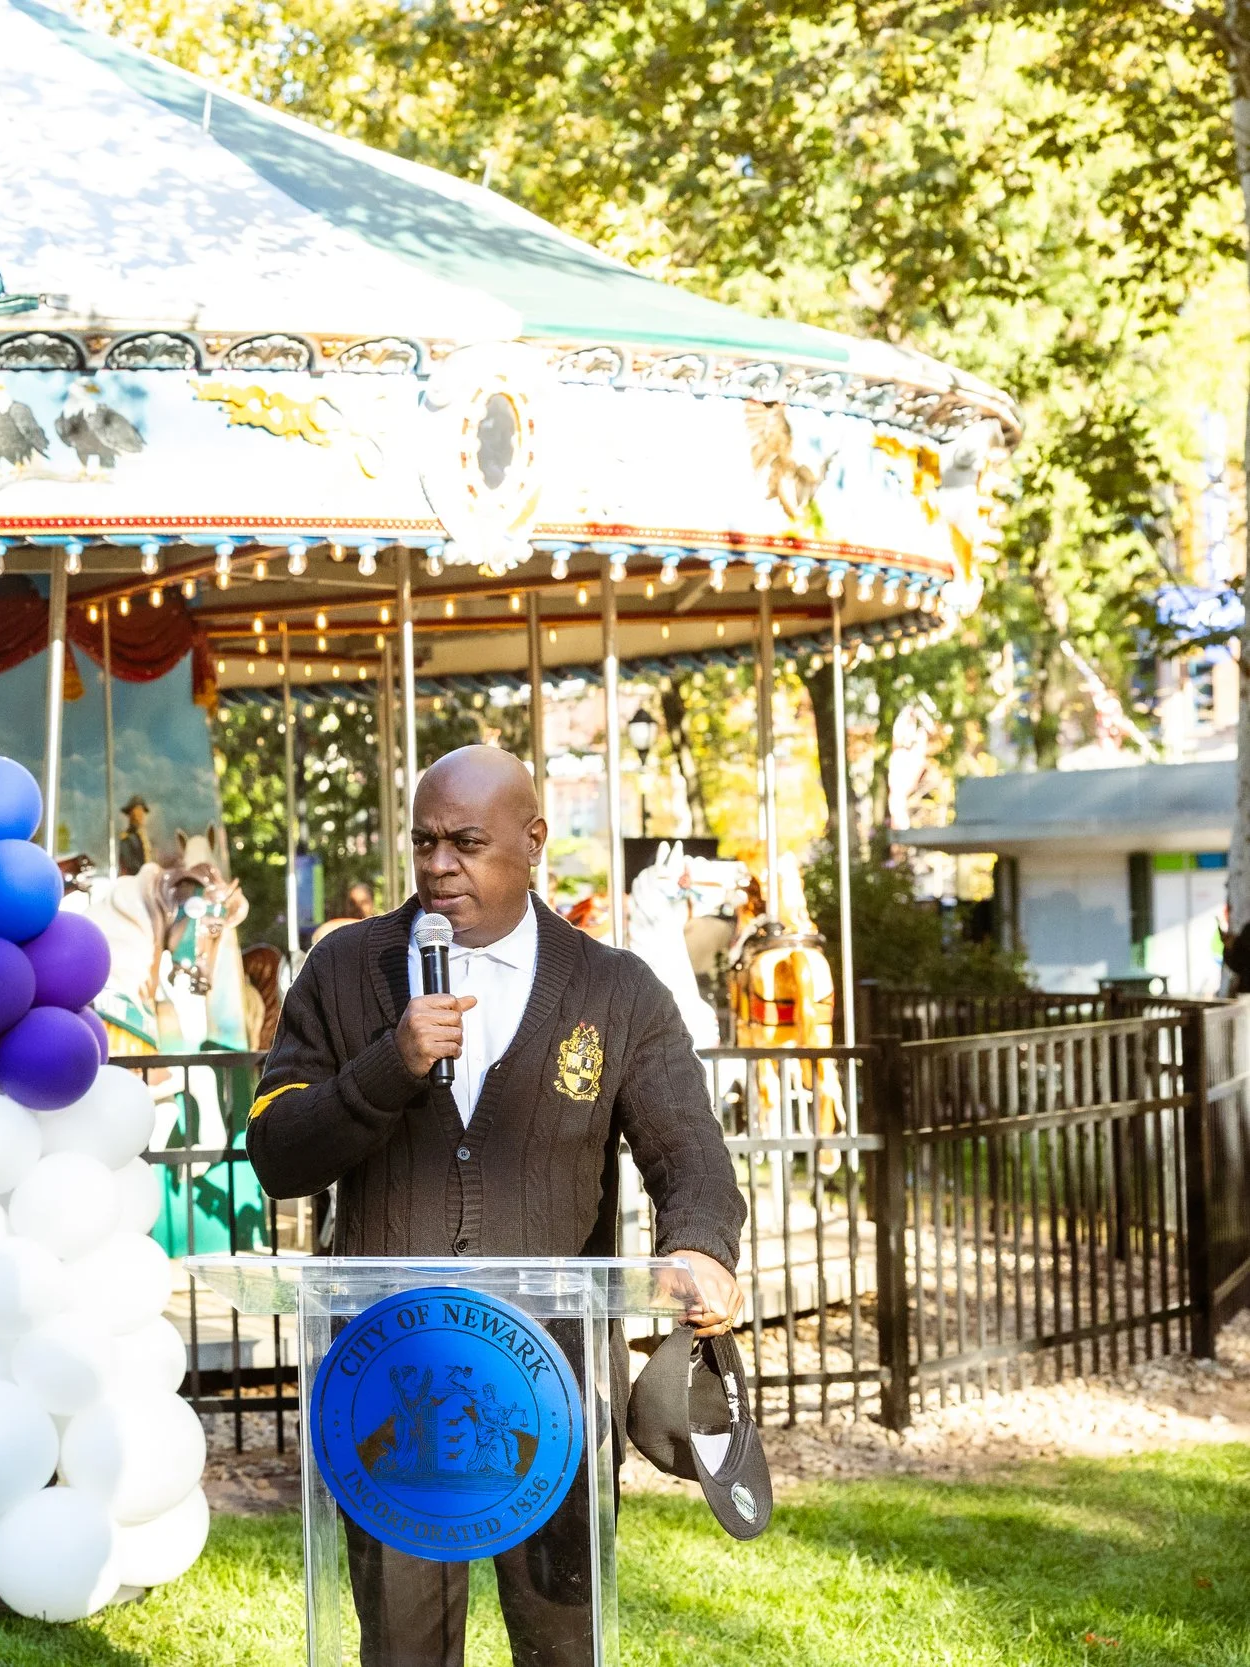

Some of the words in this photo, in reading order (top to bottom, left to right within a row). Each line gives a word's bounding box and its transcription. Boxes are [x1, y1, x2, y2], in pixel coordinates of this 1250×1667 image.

[340, 1320, 392, 1377] CITY
[396, 1304, 430, 1330] OF
[442, 1303, 551, 1383] NEWARK
[343, 1467, 501, 1543] INCORPORATED
[508, 1476, 550, 1518] 1836
